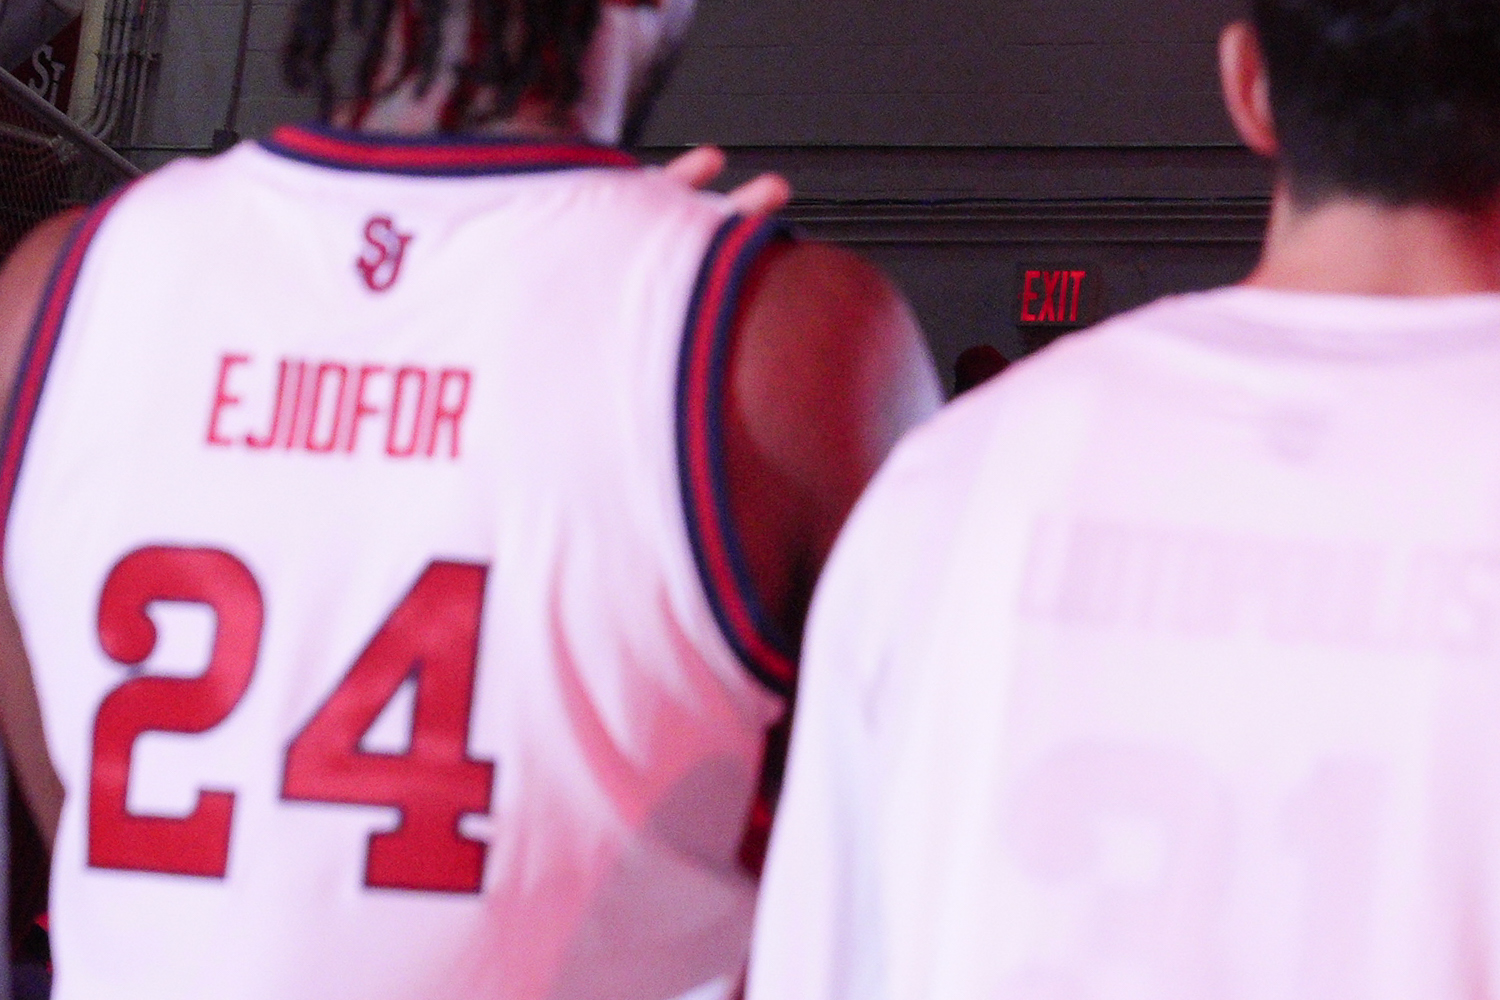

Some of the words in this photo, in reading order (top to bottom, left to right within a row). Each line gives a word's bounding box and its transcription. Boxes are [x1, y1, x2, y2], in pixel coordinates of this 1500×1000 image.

[1021, 270, 1087, 321] EXIT
[205, 352, 475, 460] EJIOFOR
[86, 541, 496, 895] 24
